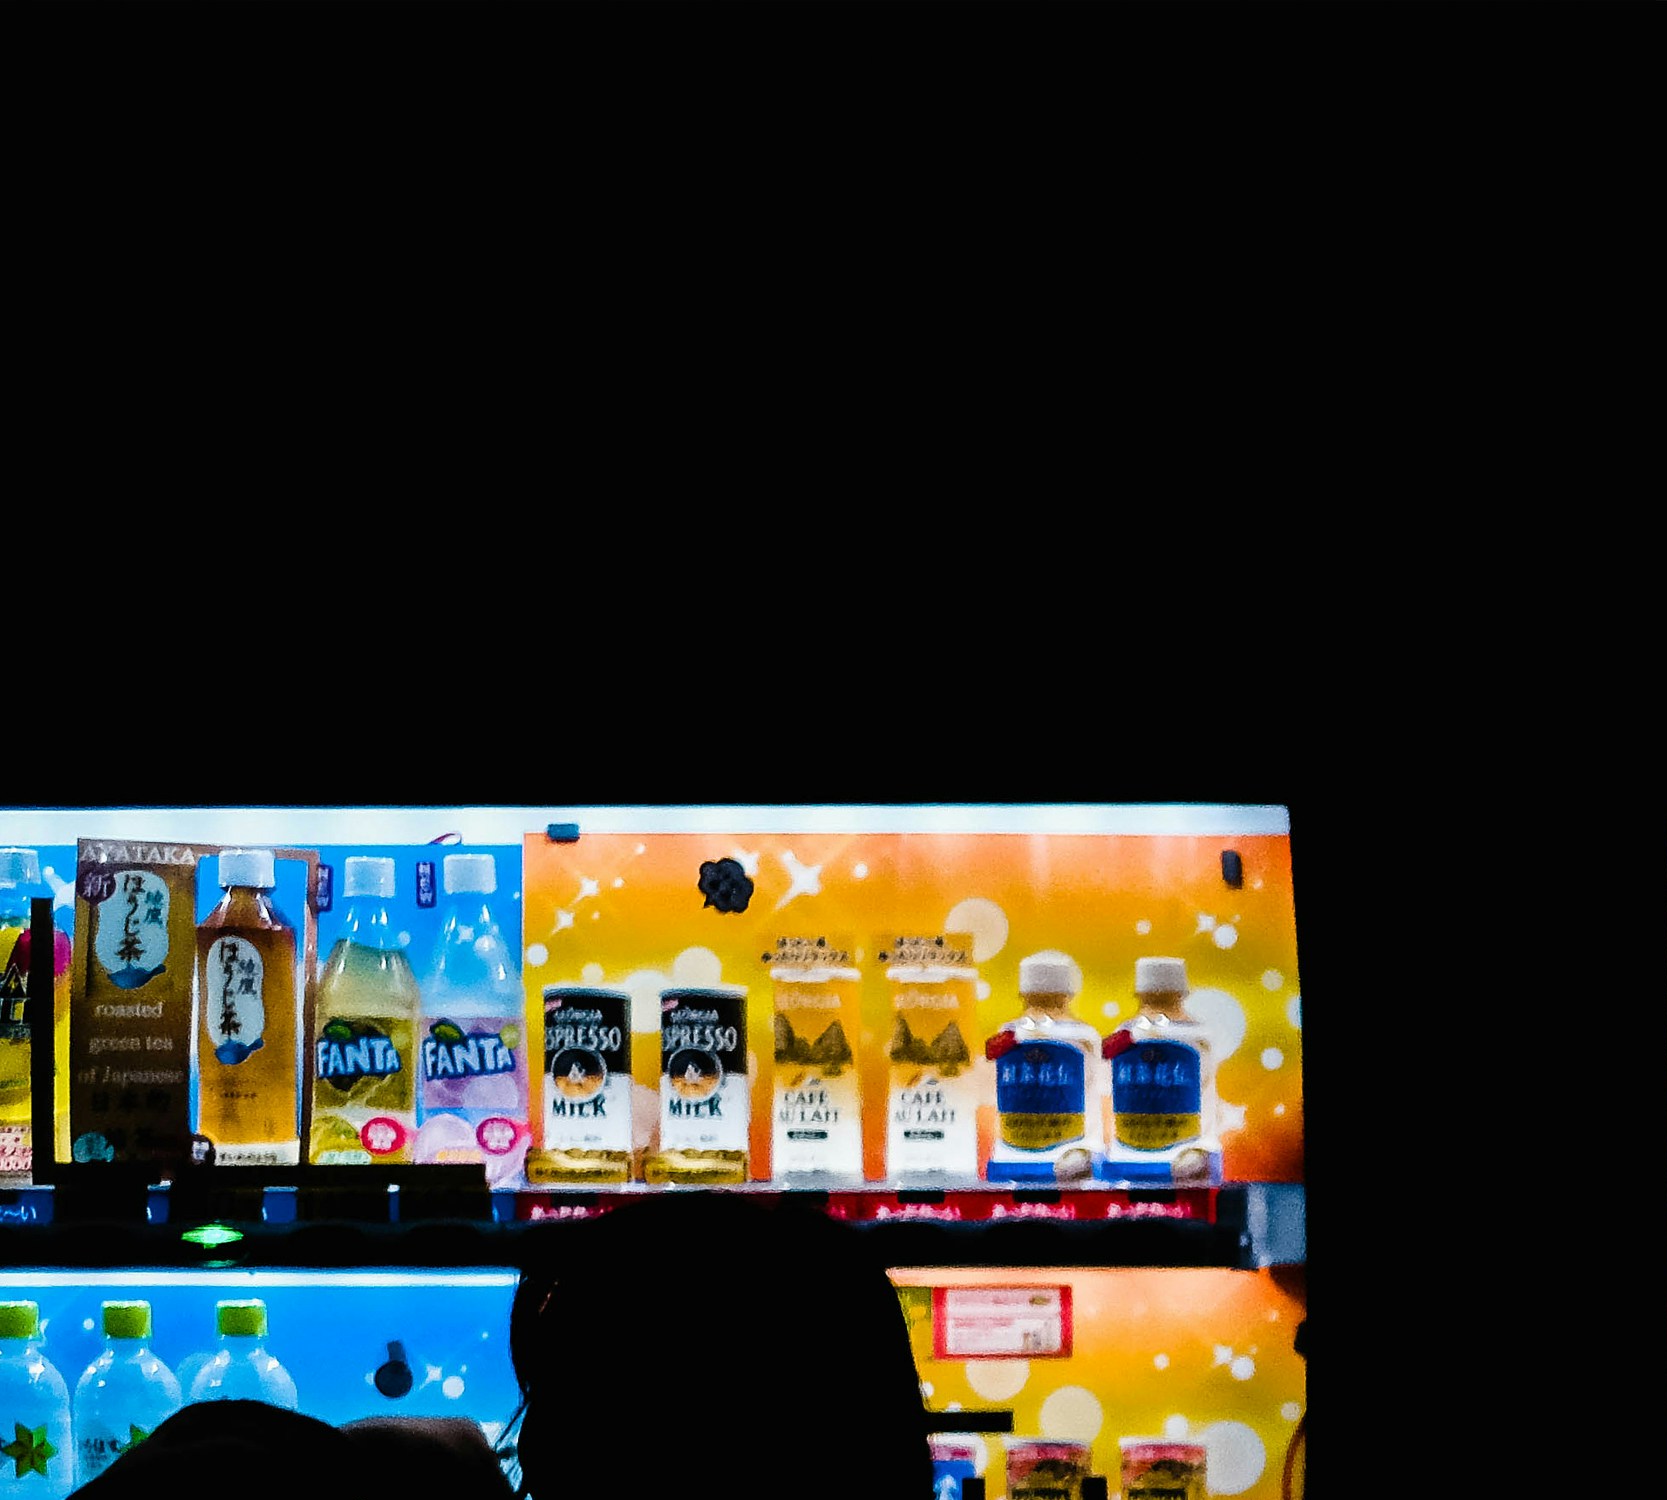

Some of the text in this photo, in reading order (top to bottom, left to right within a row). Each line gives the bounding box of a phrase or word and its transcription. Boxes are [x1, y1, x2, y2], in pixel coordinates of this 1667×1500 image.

[80, 845, 196, 865] AYATAKA
[93, 1001, 164, 1018] roasted
[88, 1034, 174, 1055] green tea
[545, 1025, 622, 1052] SPRESSO
[316, 1036, 400, 1077] FANTA
[424, 1037, 513, 1078] FANTA
[552, 1093, 606, 1118] MILK
[669, 1092, 723, 1118] MILK
